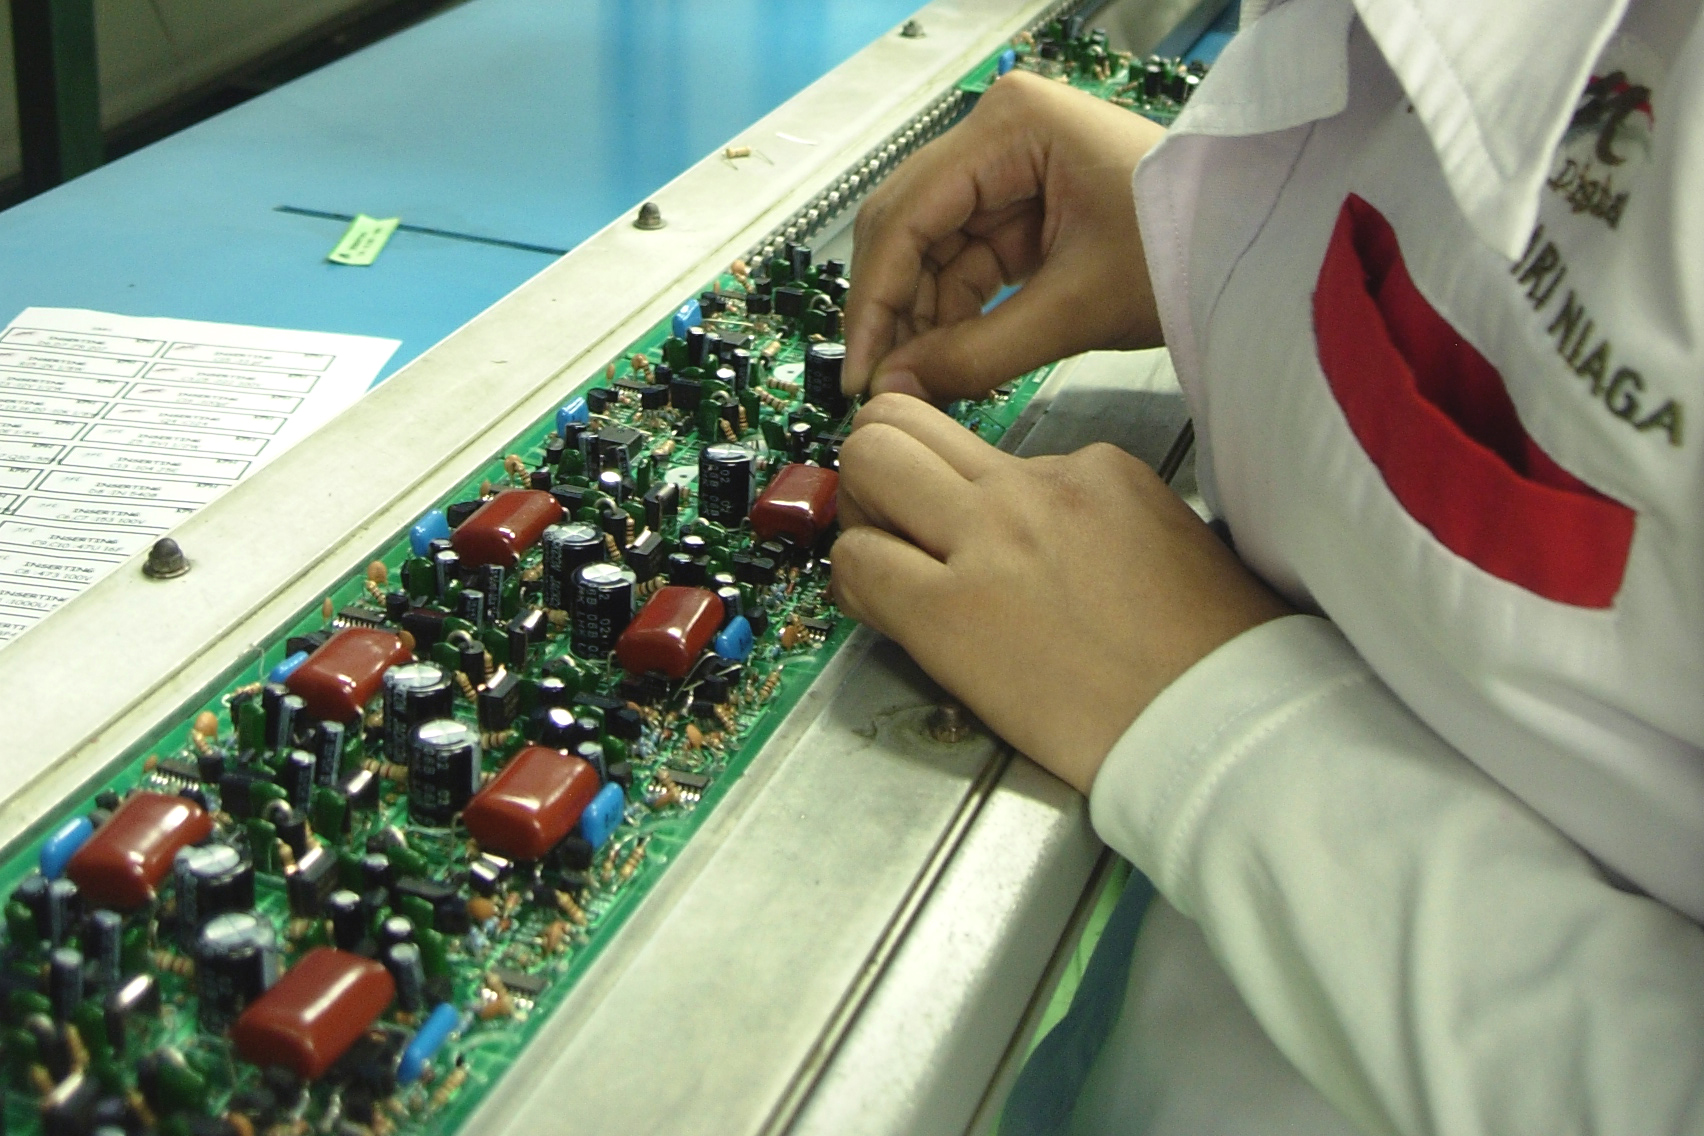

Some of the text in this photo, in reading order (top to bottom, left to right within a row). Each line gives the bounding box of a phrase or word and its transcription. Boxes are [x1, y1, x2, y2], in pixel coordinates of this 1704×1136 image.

[1548, 290, 1684, 447] NIAGA
[73, 508, 140, 517] INSERTING
[49, 534, 119, 544] INSERTING
[24, 561, 95, 573] INSERTING
